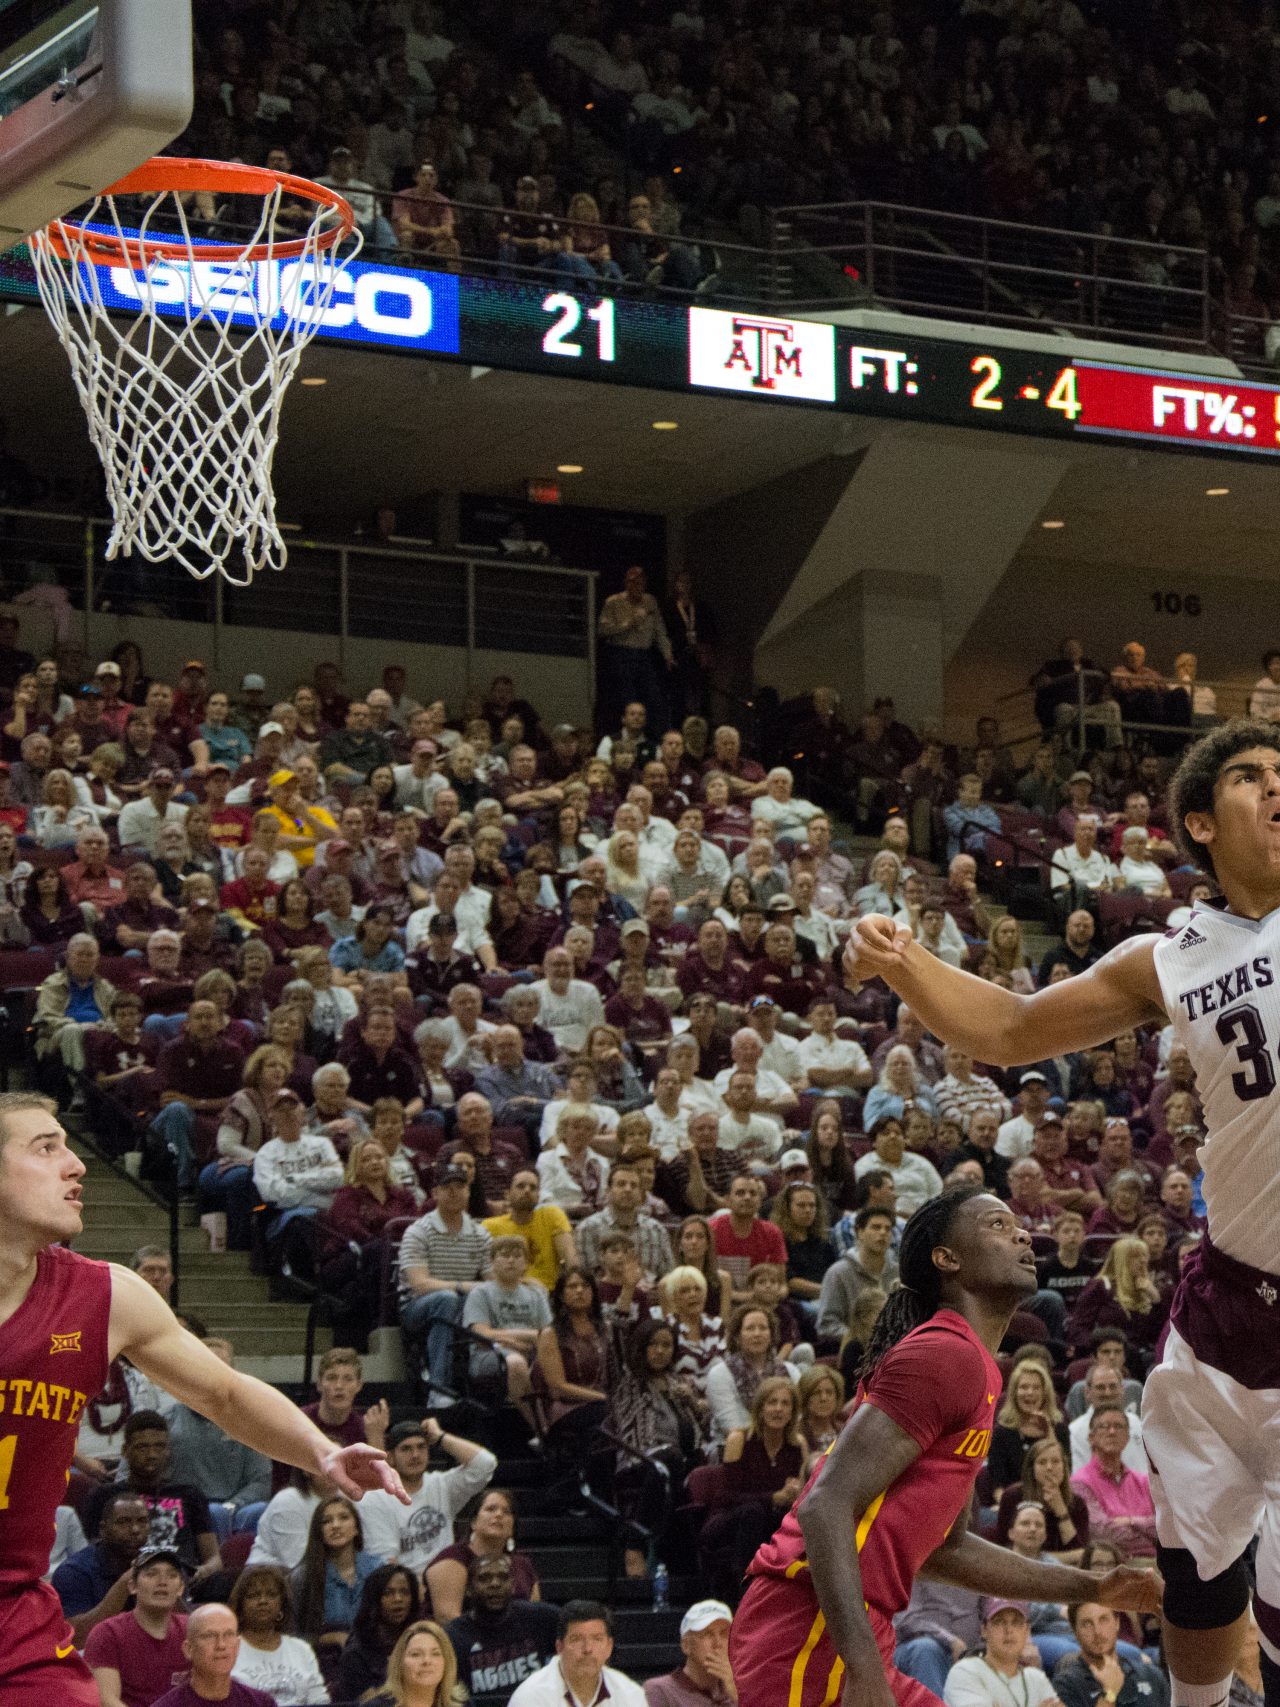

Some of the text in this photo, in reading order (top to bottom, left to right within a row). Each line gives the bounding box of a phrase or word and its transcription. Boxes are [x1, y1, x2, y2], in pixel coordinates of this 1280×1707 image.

[110, 260, 433, 338] GEICO
[542, 292, 615, 361] 21
[850, 345, 919, 395] FT:
[971, 355, 1003, 411] 2
[1152, 386, 1257, 437] FT%:
[1152, 590, 1202, 617] 106
[1179, 936, 1207, 951] adidas
[1179, 956, 1274, 1022] TEXAS
[471, 1651, 541, 1694] AGGIES
